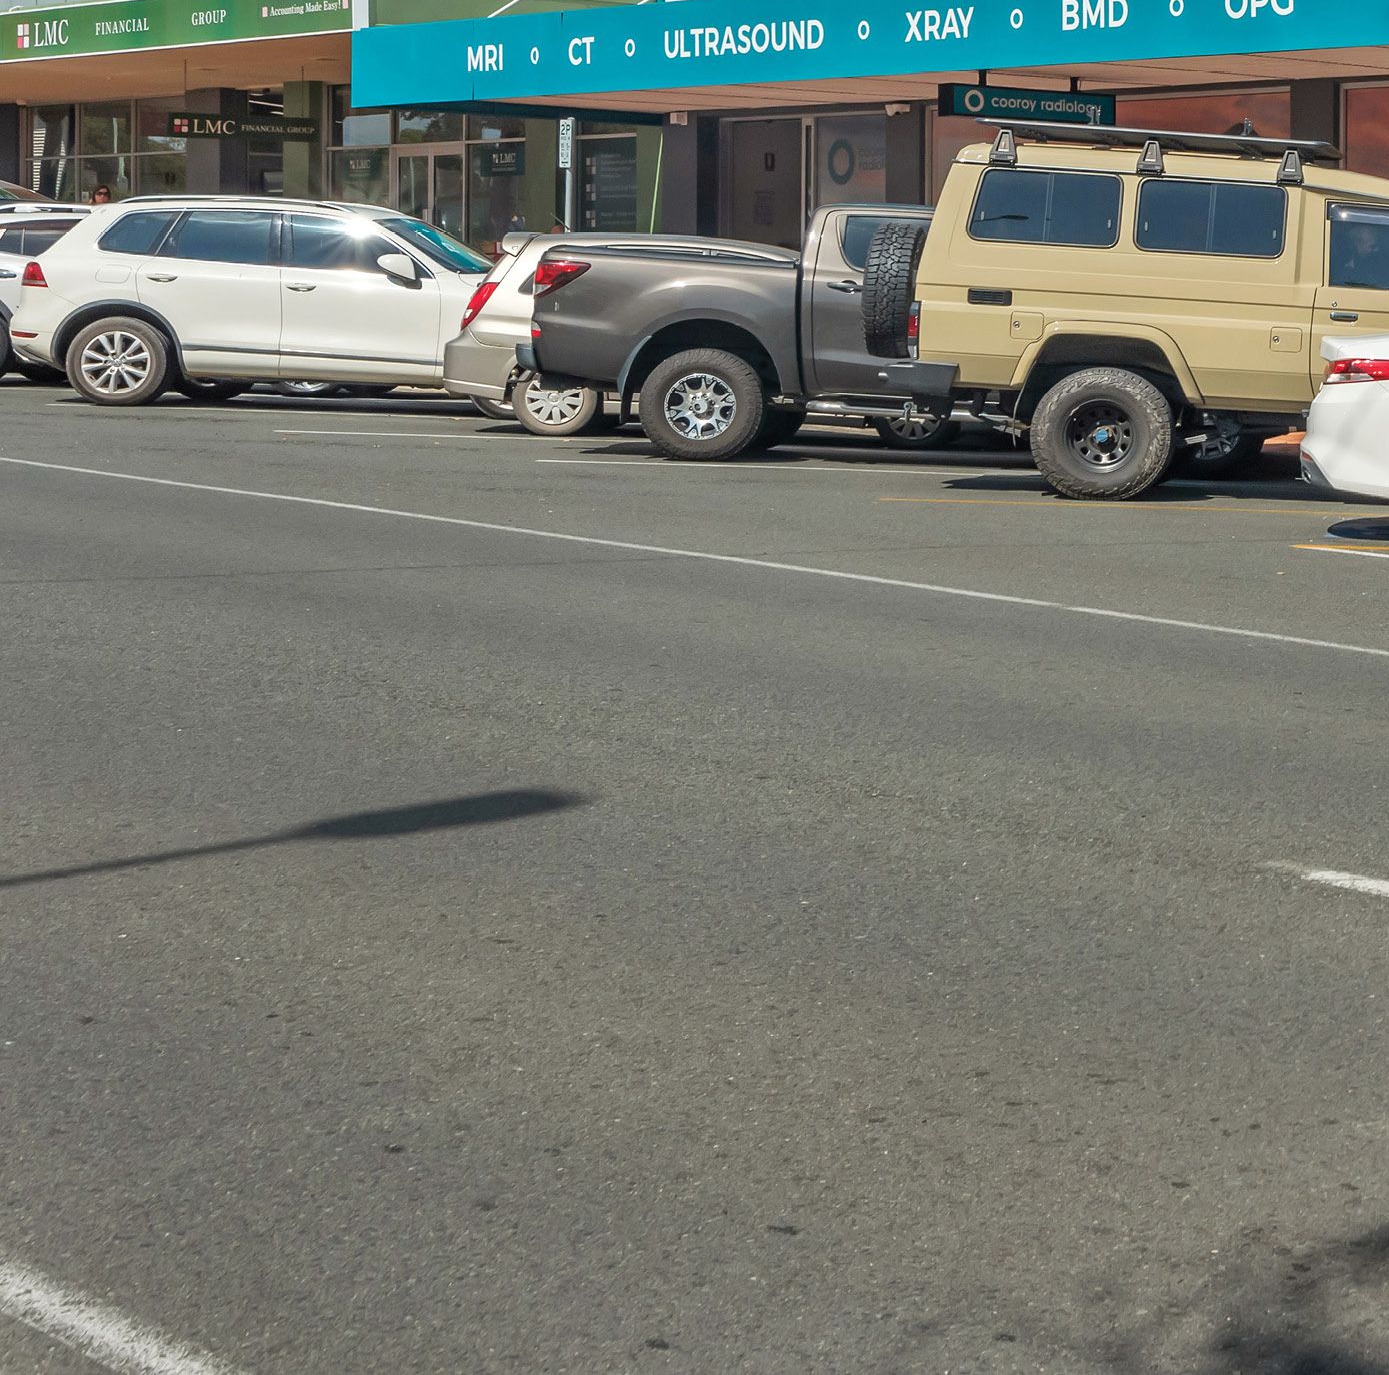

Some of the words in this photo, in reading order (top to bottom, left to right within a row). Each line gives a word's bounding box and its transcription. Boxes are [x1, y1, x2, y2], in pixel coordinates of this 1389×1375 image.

[269, 4, 304, 18] Accounting
[305, 1, 322, 13] Made
[34, 19, 69, 47] LMC
[95, 17, 149, 36] FINANCIAL
[191, 9, 226, 26] GROUP
[467, 43, 503, 72] MRI
[568, 36, 595, 66] CT
[664, 19, 824, 59] ULTRASOUND
[904, 6, 975, 43] XRAY
[991, 97, 1036, 112] cooroy
[193, 120, 236, 135] LMC
[241, 124, 285, 133] FINANCIAL
[287, 127, 315, 135] GROUP
[560, 124, 570, 136] 2P
